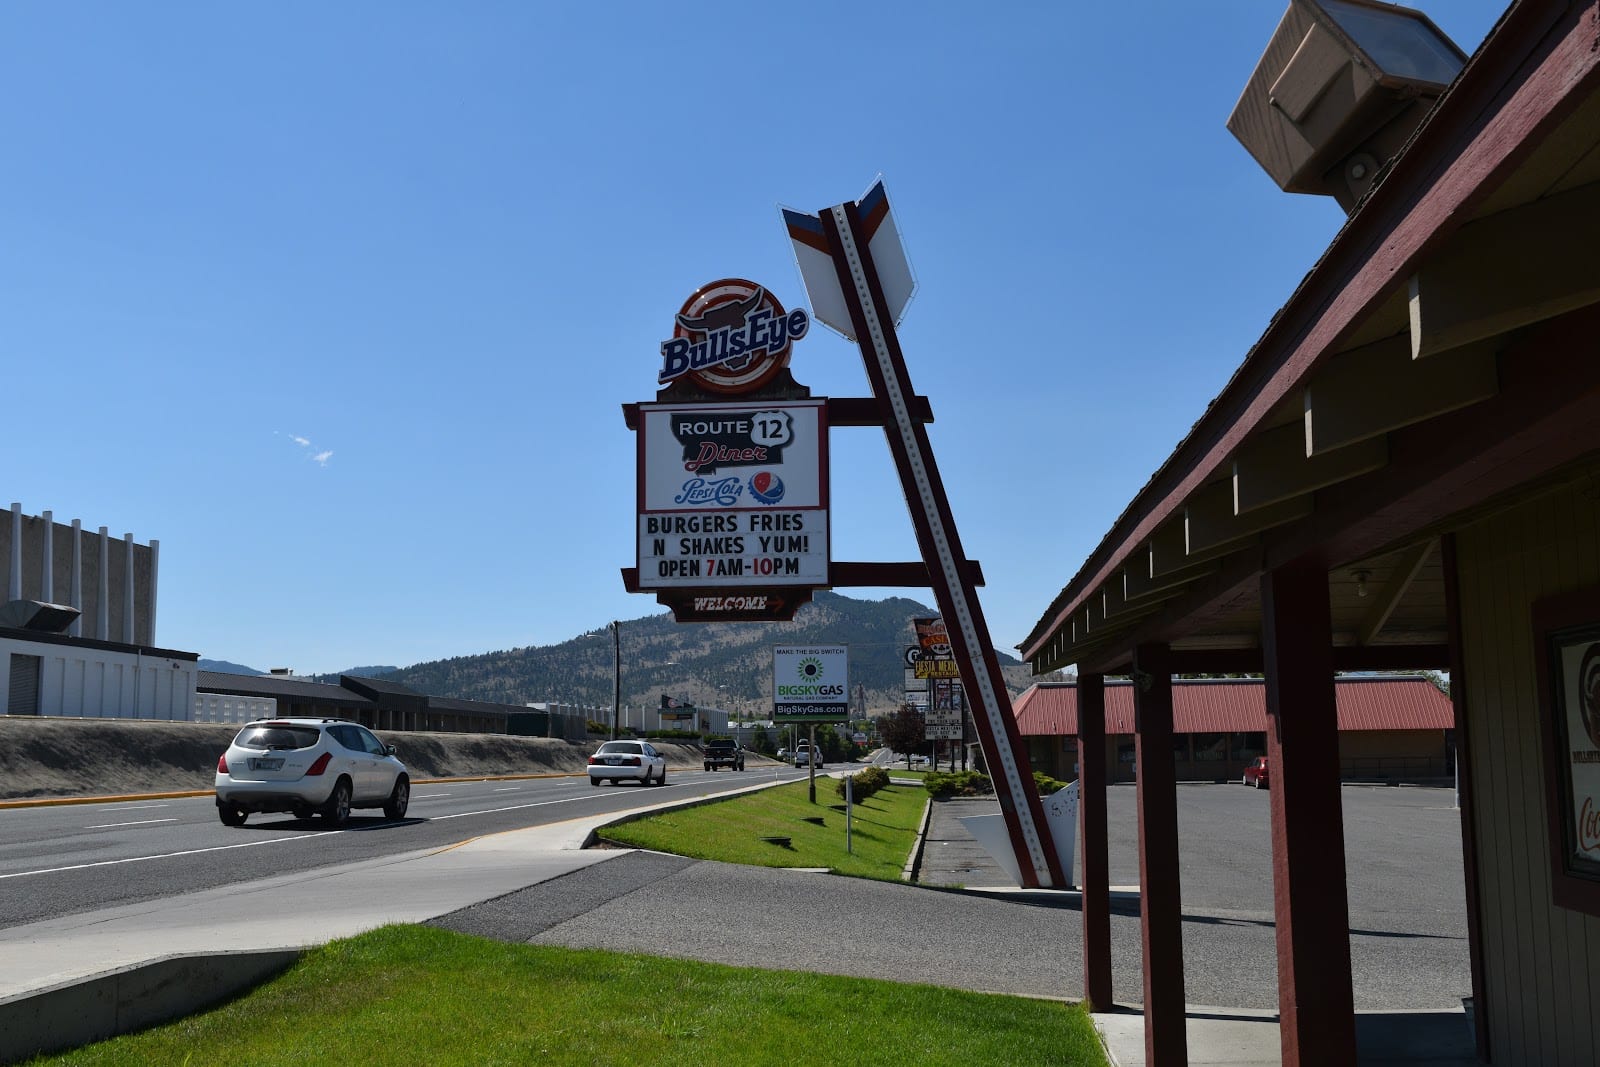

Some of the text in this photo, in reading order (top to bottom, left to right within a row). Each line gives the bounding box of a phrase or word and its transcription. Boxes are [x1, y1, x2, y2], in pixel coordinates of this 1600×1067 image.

[659, 309, 808, 382] BullsEye
[679, 419, 783, 439] ROUTE 12
[684, 441, 768, 472] Diner
[647, 513, 803, 534] BURGERS FRIES
[653, 535, 809, 556] N SHAKES YUM!
[658, 557, 799, 577] OPEN 7AM-10PM
[694, 596, 768, 611] WELCOME
[915, 660, 936, 673] FIESTA
[777, 705, 845, 714] BigSkyGas.com
